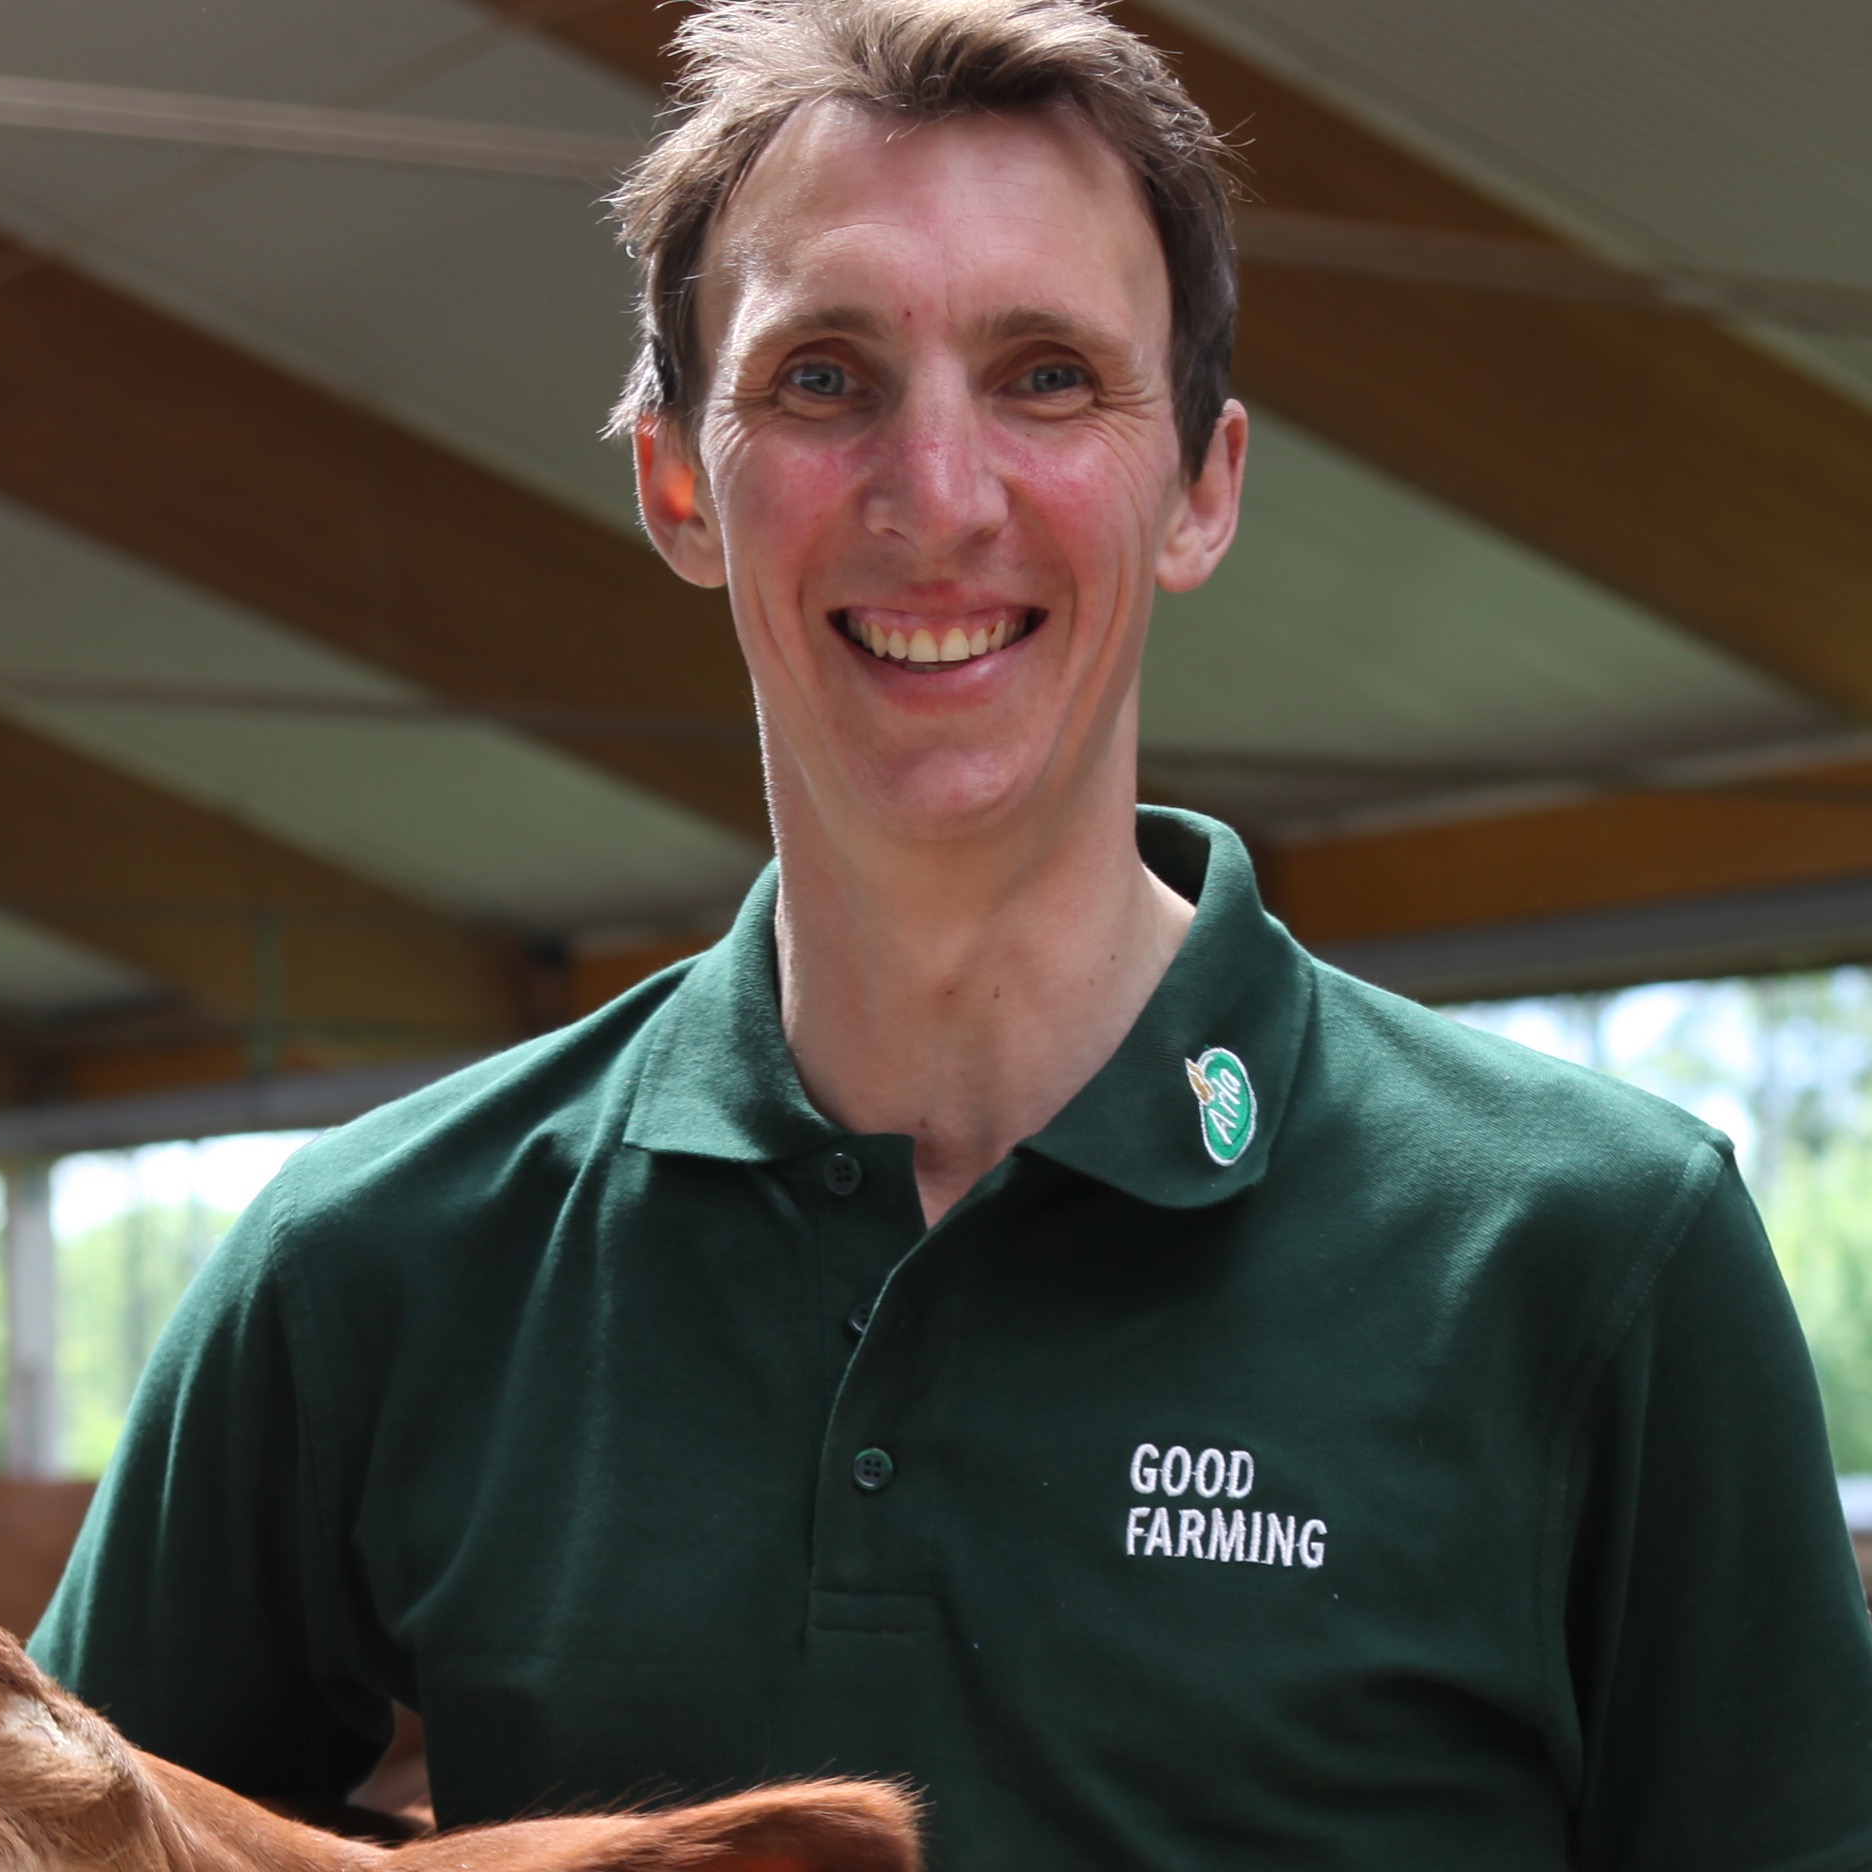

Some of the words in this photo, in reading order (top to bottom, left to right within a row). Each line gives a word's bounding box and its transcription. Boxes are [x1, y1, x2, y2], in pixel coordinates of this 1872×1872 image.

[1208, 1068, 1241, 1145] Arla
[1130, 1443, 1255, 1499] GOOD
[1127, 1506, 1328, 1569] FARMING
